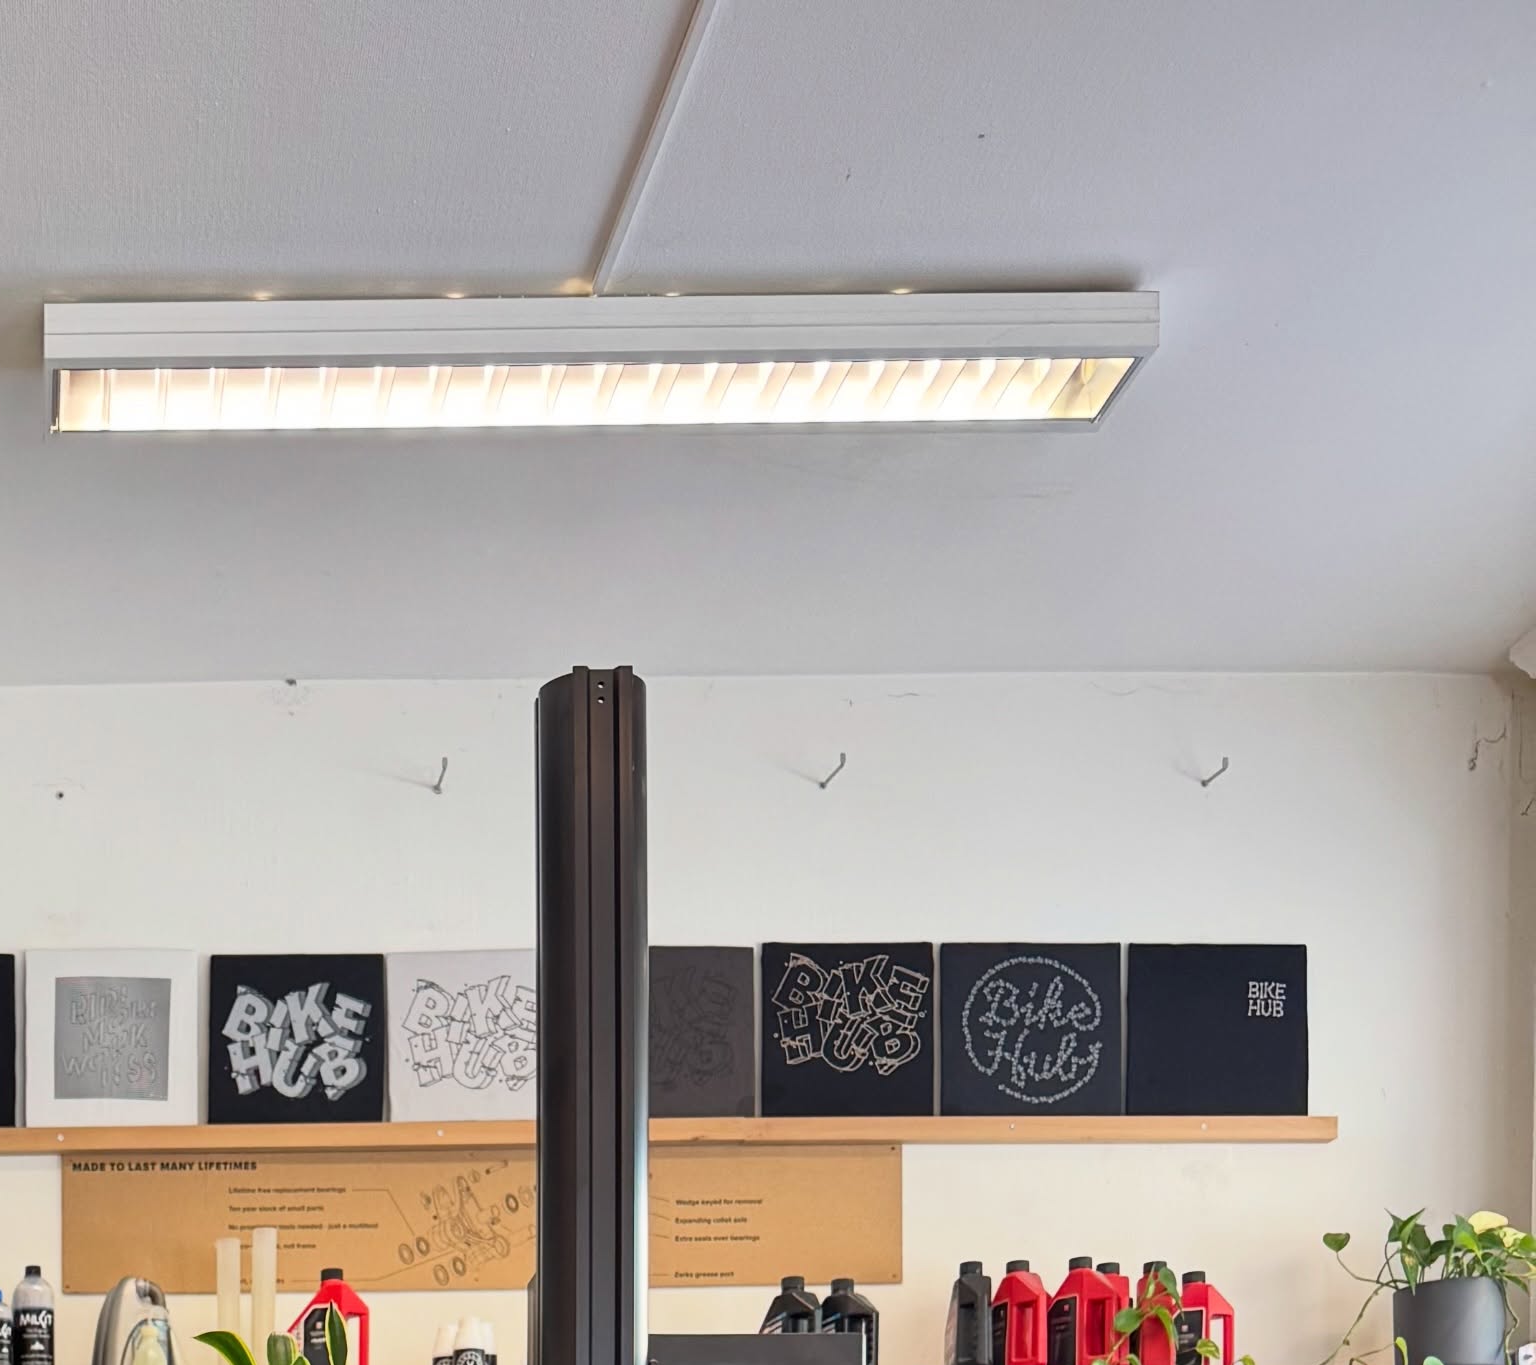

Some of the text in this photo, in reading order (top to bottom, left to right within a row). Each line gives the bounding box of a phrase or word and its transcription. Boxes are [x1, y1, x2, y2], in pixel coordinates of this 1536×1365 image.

[221, 982, 372, 1053] BIKE
[772, 952, 930, 1028] BIKE
[979, 976, 1101, 1030] Bike
[1248, 982, 1287, 1000] BIKE
[1248, 1000, 1285, 1017] HUB
[224, 1034, 368, 1101] HUB
[777, 1007, 921, 1075] HUB
[985, 1028, 1102, 1089] Hub
[72, 1161, 257, 1172] MADE TO LAST MANY LIFETIMES
